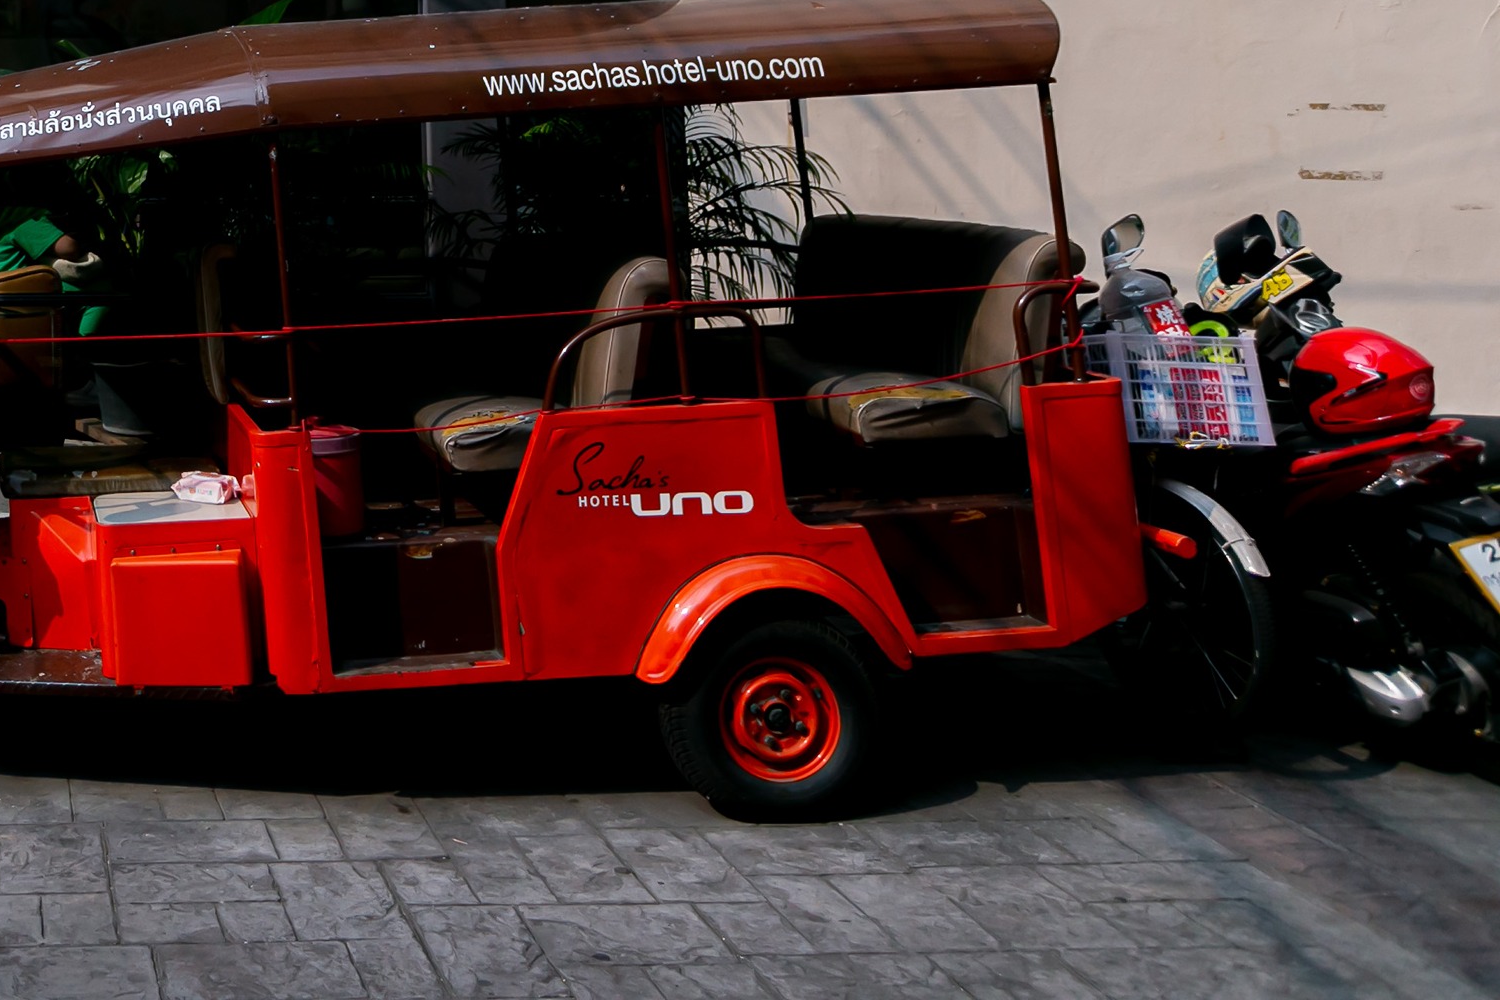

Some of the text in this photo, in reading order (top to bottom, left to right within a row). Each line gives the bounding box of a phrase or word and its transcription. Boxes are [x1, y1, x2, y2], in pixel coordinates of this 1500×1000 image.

[482, 55, 825, 97] www.sachas.hotel-uno.com
[556, 441, 670, 496] Sacha's
[578, 495, 630, 508] HOTEL
